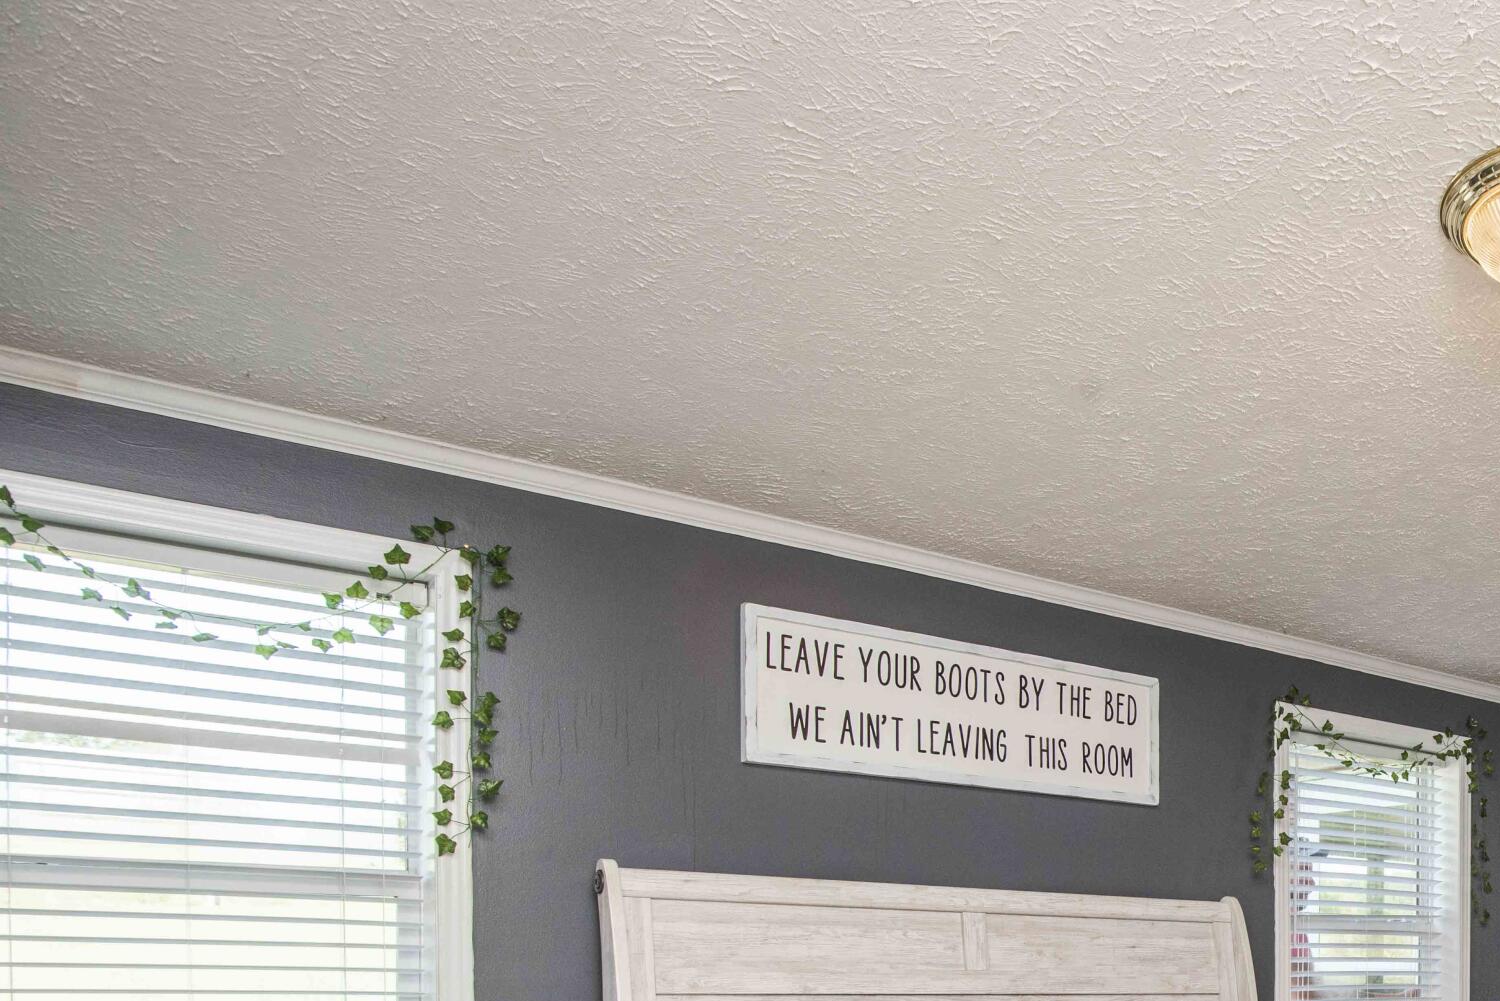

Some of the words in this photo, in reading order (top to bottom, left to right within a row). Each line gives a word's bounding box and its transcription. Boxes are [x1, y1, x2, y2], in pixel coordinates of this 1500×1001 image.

[766, 631, 846, 681] LEAVE
[858, 646, 922, 692] YOUR
[935, 660, 1006, 706] BOOTS
[1018, 674, 1045, 712] BY
[1055, 681, 1092, 720] THE
[1104, 689, 1138, 726] BED
[788, 701, 827, 744] WE
[839, 709, 904, 752] AIN'T
[917, 718, 1008, 763] LEAVING
[1024, 734, 1068, 771] THIS
[1081, 741, 1134, 779] ROOM
